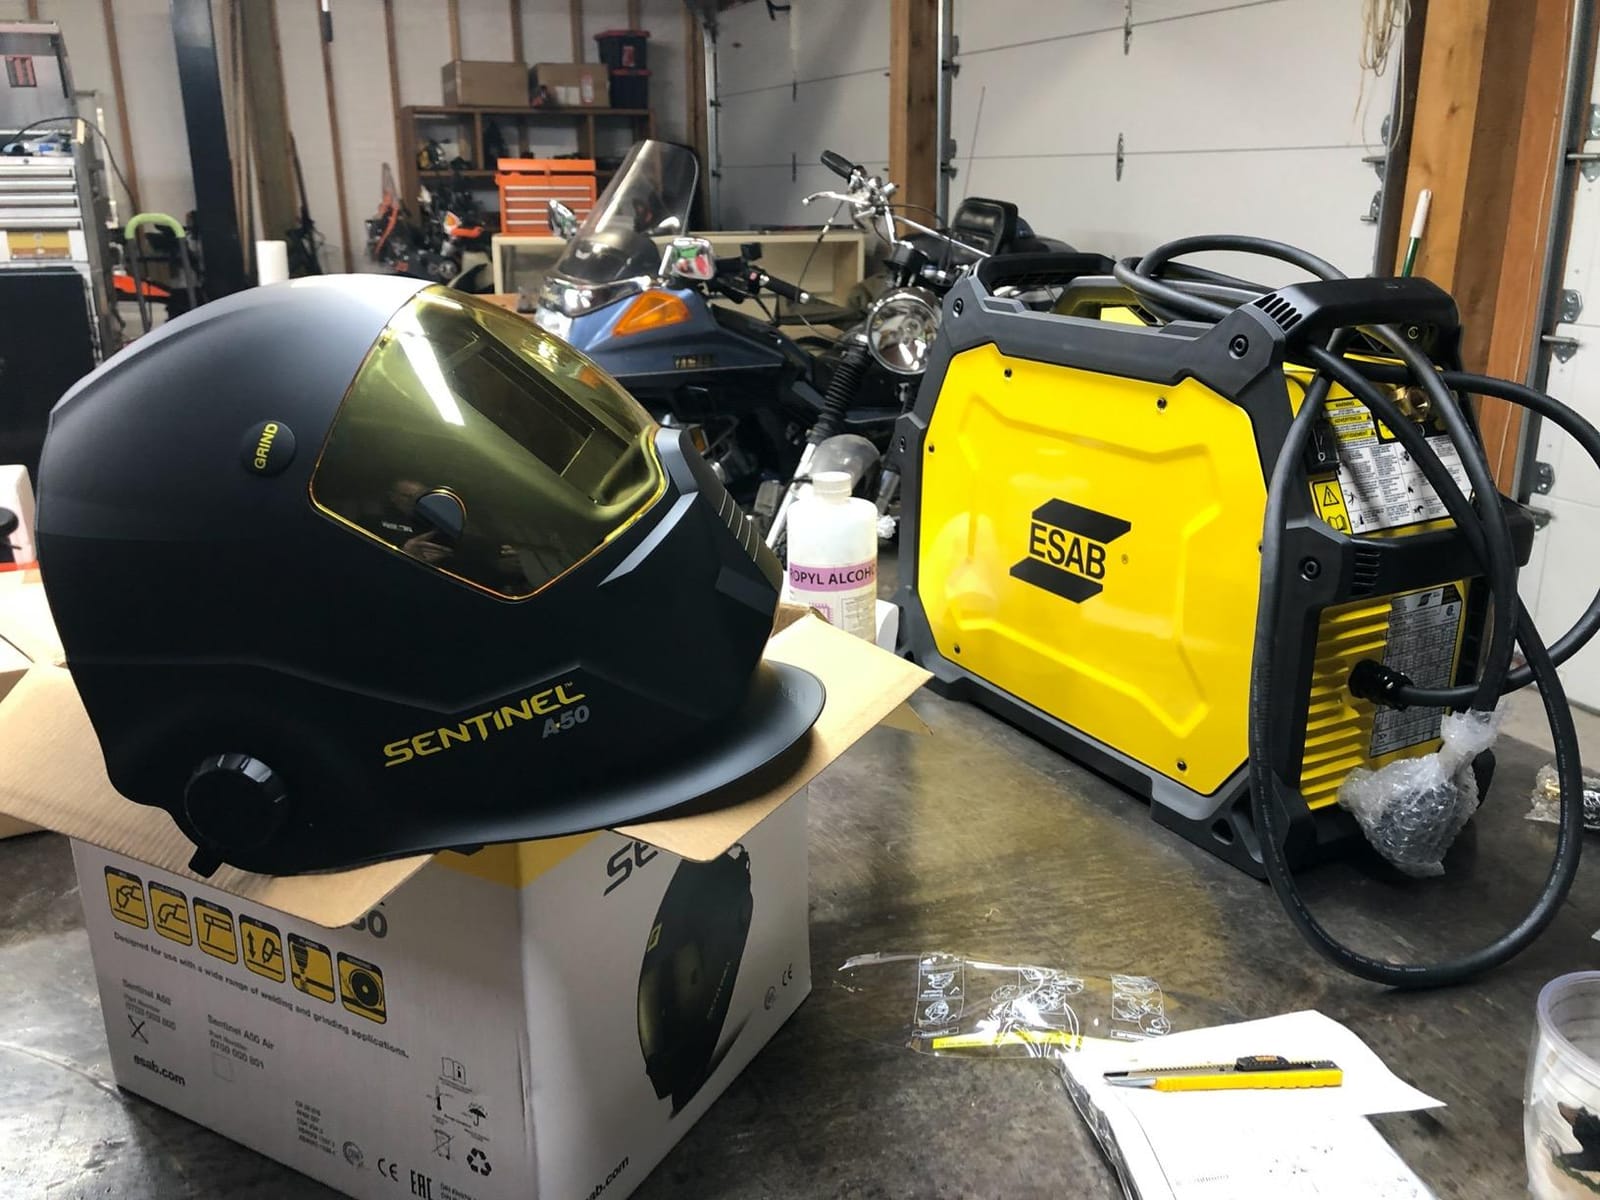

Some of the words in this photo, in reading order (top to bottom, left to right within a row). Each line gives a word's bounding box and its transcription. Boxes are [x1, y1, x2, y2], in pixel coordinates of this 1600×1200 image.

[254, 422, 279, 469] GRIND
[1029, 522, 1106, 580] ESAB
[113, 931, 149, 953] Designed
[151, 945, 161, 956] for
[163, 953, 178, 963] use
[179, 957, 196, 970] with
[204, 967, 223, 981] wide
[225, 976, 248, 992] range
[250, 986, 258, 995] of
[260, 991, 293, 1012] welding
[295, 1006, 311, 1018] and
[313, 1012, 349, 1035] grinding
[351, 1028, 409, 1059] applications.
[207, 1014, 241, 1036] Sentinel
[262, 1038, 275, 1050] Air
[133, 1054, 186, 1086] esab.com
